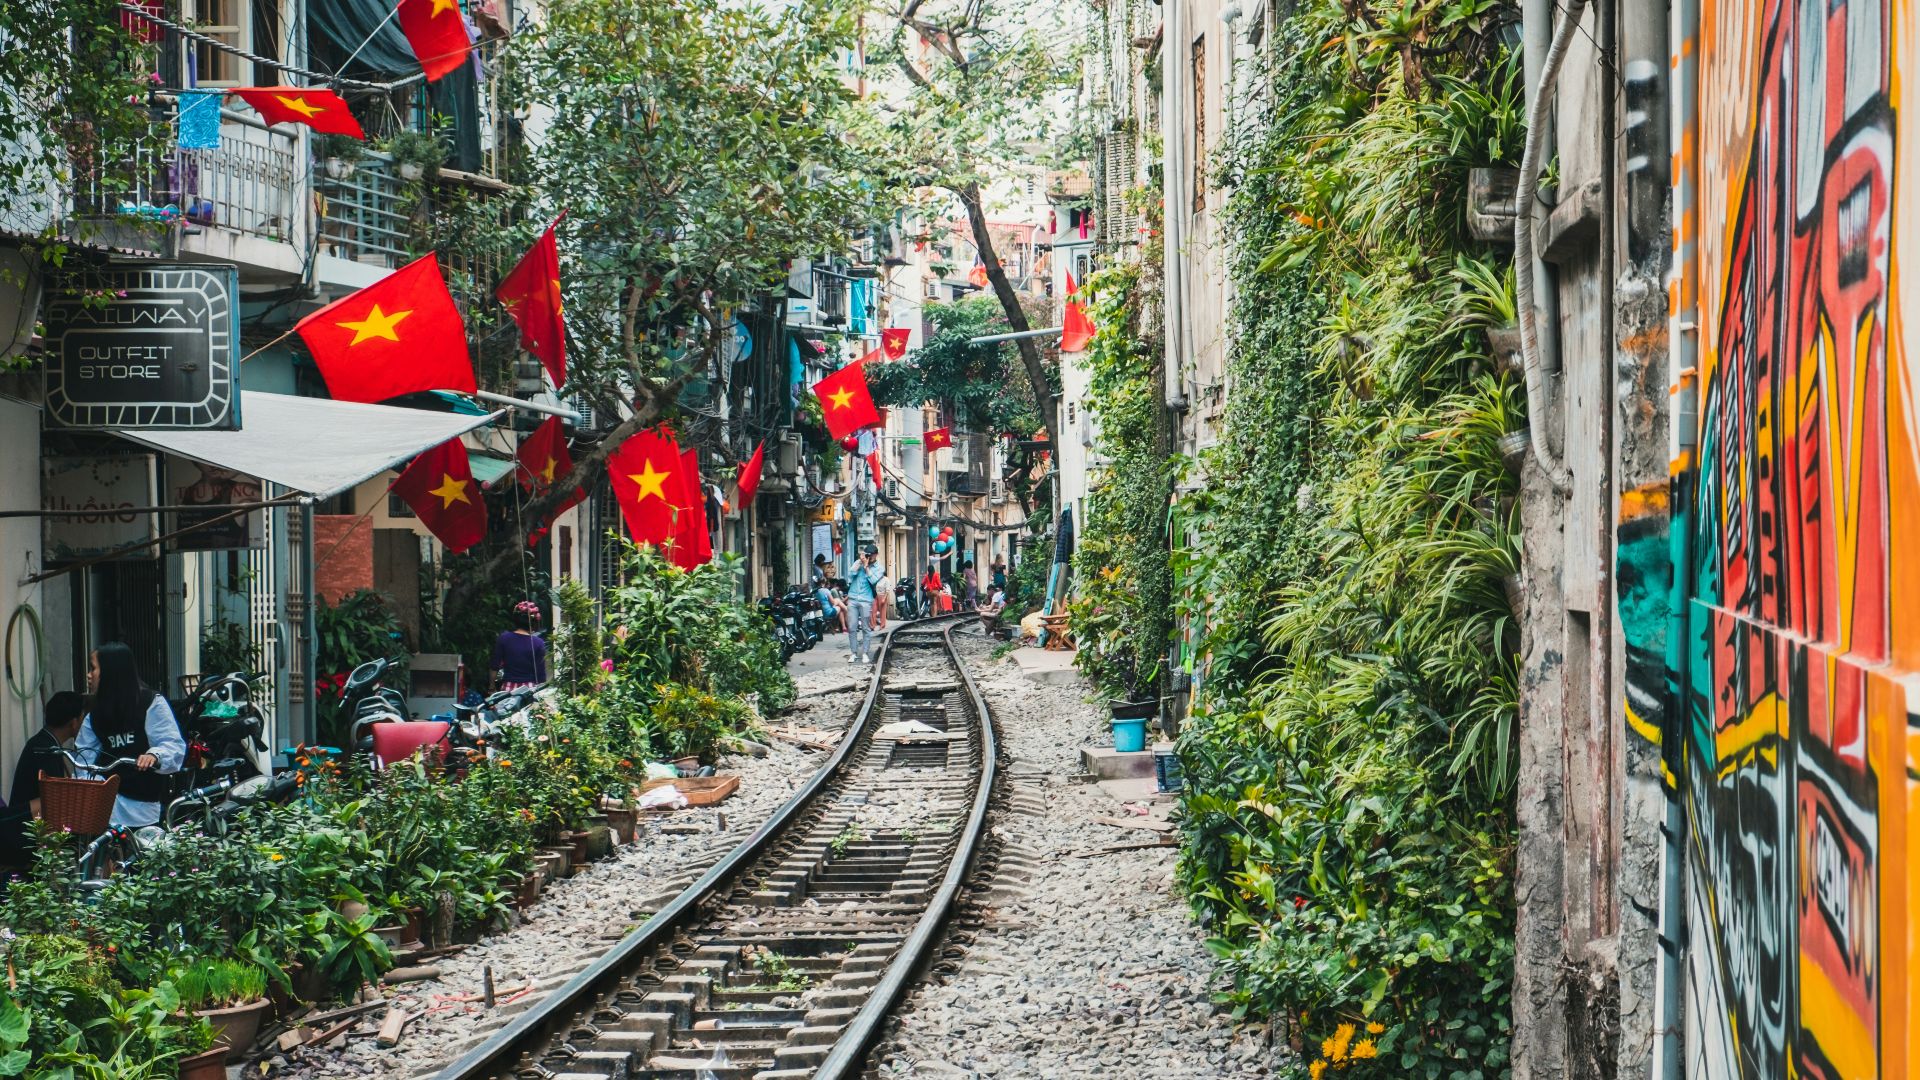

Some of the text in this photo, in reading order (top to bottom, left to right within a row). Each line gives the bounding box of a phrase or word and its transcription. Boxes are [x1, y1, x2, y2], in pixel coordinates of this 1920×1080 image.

[48, 307, 206, 324] RAILWAY
[79, 346, 173, 360] OUTFIT
[79, 365, 161, 379] STORE
